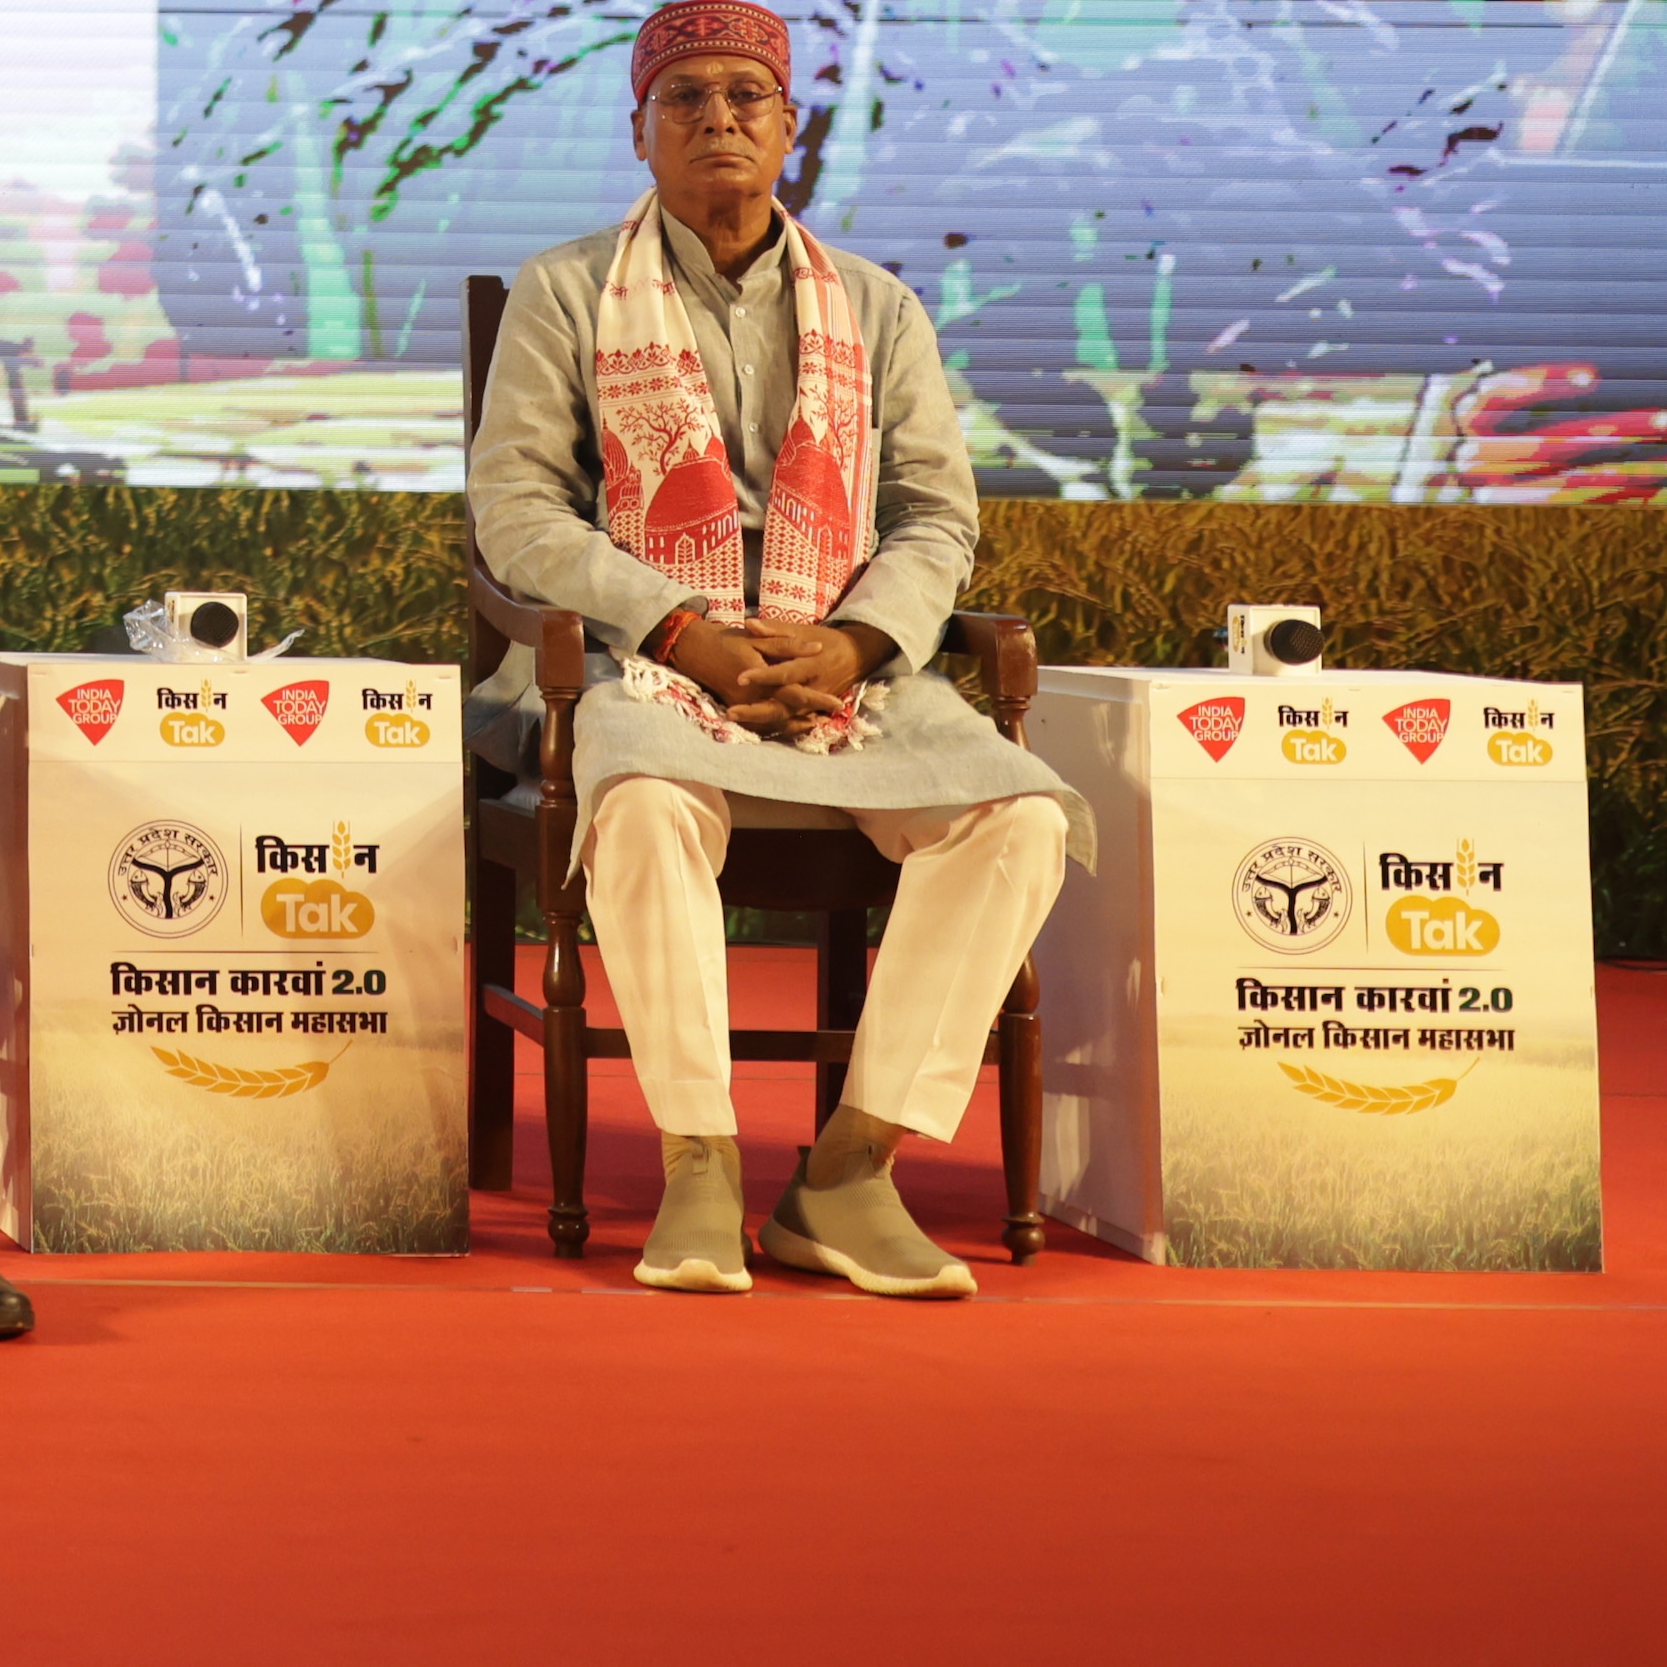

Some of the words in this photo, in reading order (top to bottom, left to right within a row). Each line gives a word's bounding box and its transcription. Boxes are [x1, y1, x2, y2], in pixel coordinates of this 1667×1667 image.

[77, 689, 112, 700] INDIA
[281, 689, 316, 700] INDIA
[68, 700, 121, 713] TODAY
[273, 700, 326, 714] TODAY
[1198, 706, 1233, 716] INDIA
[1403, 708, 1438, 718] INDIA
[72, 713, 116, 724] GROUP
[277, 714, 322, 725] GROUP
[1189, 716, 1242, 730] TODAY
[1394, 718, 1447, 732] TODAY
[169, 720, 215, 743] Tak
[374, 721, 420, 744] Tak
[1194, 730, 1238, 741] GROUP
[1399, 732, 1444, 743] GROUP
[1290, 737, 1337, 761] Tak
[1496, 739, 1543, 763] Tak
[276, 894, 358, 933] Tak
[1401, 910, 1483, 950] Tak
[111, 962, 219, 995] किसान
[229, 961, 326, 995] कारवां
[332, 970, 386, 995] 2.0
[1236, 978, 1345, 1011] किसान
[1355, 979, 1452, 1013] कारवां
[1459, 987, 1513, 1012] 2.0
[195, 1005, 283, 1033] किसान
[291, 1012, 388, 1034] महासभा
[1322, 1021, 1410, 1049] किसान
[1418, 1029, 1515, 1051] महासभा
